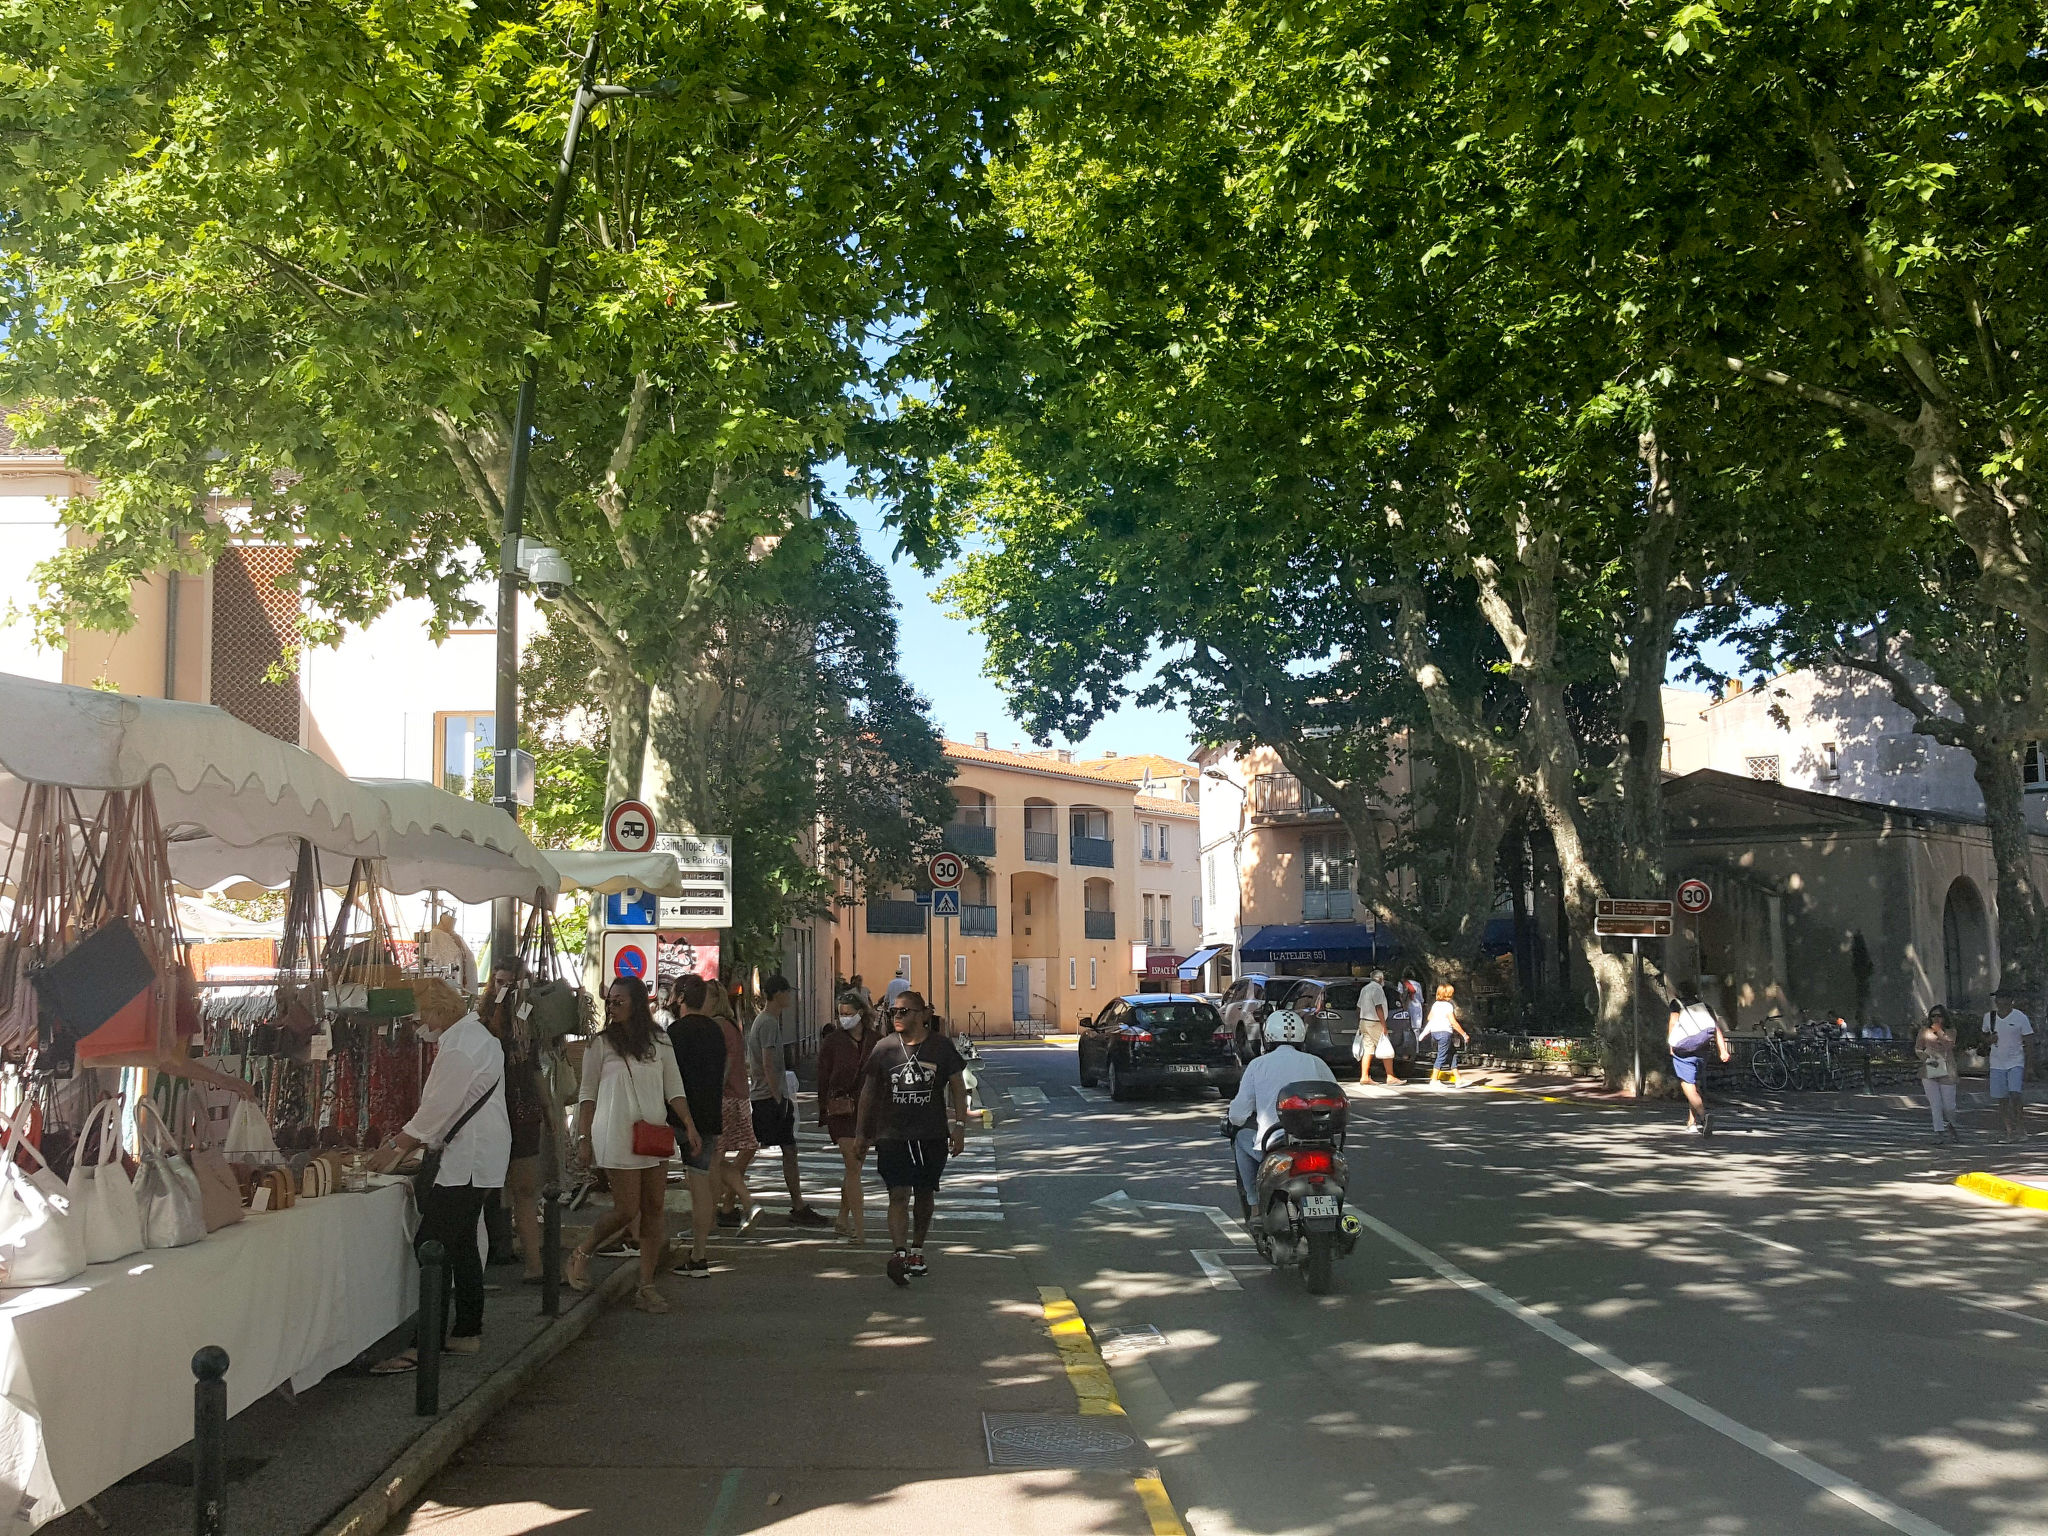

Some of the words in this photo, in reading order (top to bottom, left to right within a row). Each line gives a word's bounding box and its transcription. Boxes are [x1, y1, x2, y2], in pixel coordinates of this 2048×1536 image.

[662, 837, 707, 852] Saint-Tropez
[692, 855, 728, 866] Parkings
[936, 862, 957, 878] 30
[620, 886, 644, 915] P
[1683, 889, 1704, 904] 30
[1151, 966, 1171, 975] ESPACE
[908, 1092, 932, 1106] Floyd
